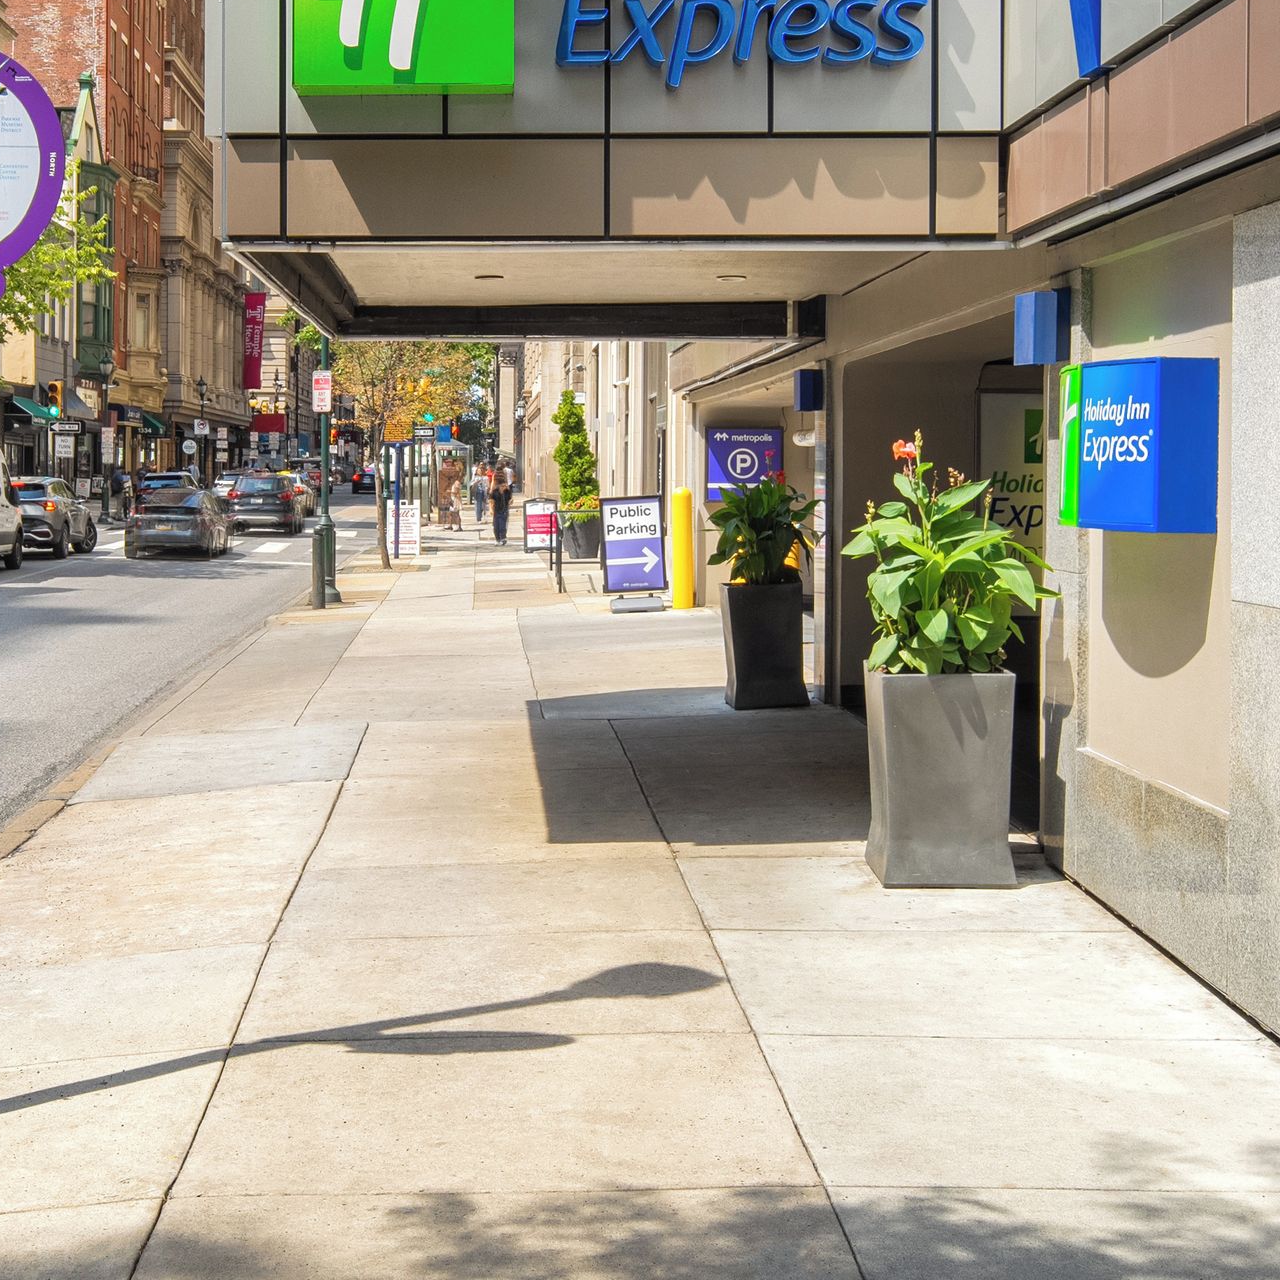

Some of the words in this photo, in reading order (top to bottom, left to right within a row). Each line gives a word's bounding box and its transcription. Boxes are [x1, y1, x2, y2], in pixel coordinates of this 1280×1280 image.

[245, 324, 253, 355] Health
[252, 324, 262, 357] Temple
[1084, 397, 1125, 426] Holiday
[1126, 395, 1150, 420] Inn
[731, 433, 773, 443] metropolis
[1083, 429, 1149, 471] Express
[736, 454, 752, 473] P
[609, 507, 651, 519] Public
[606, 523, 657, 536] Parking
